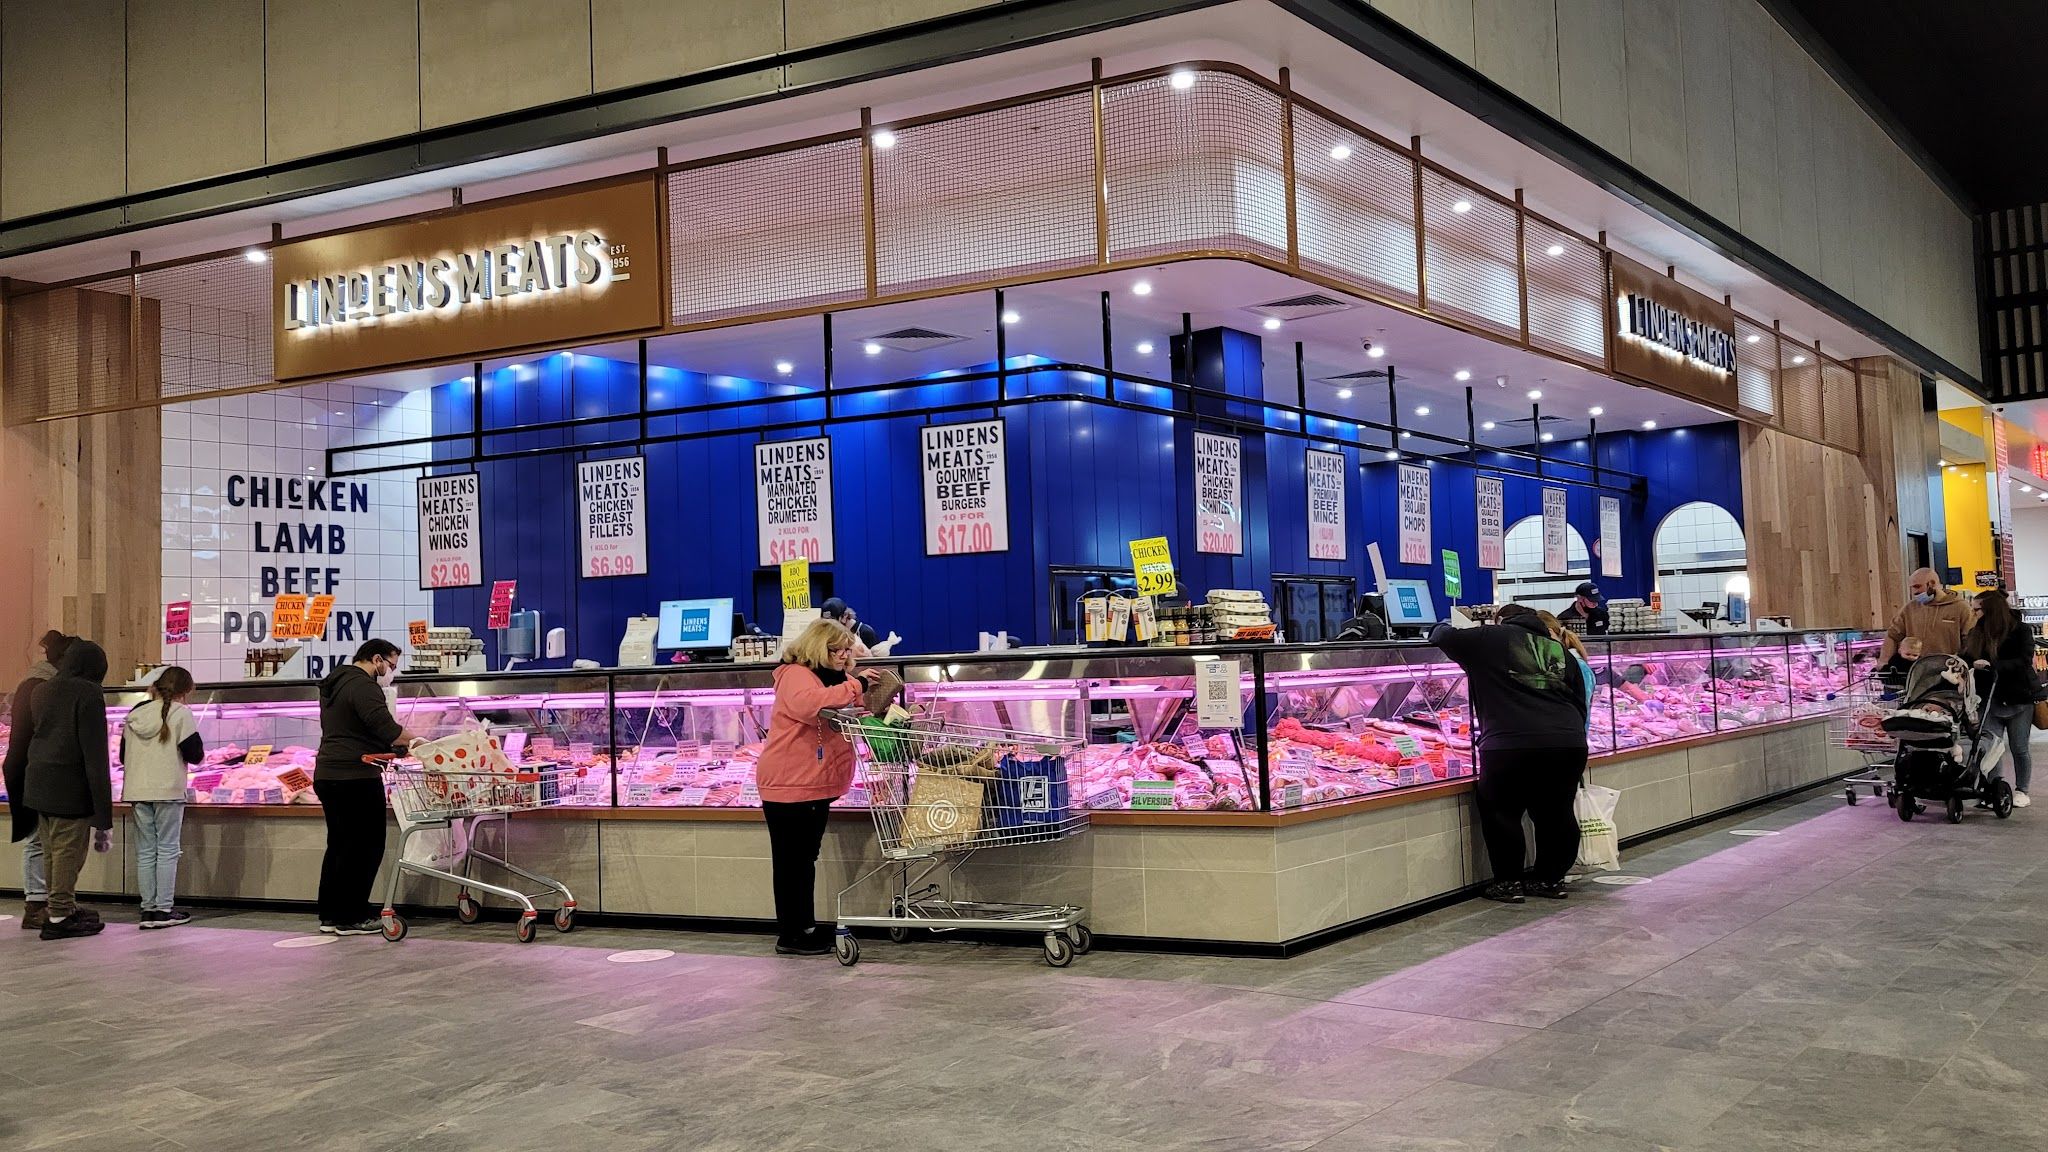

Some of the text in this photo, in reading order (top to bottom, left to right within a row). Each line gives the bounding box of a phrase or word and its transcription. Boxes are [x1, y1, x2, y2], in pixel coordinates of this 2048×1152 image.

[610, 244, 629, 256] EST.
[610, 256, 630, 268] 1956
[927, 426, 998, 450] LINDENS
[760, 442, 825, 466] LINDENS
[1197, 436, 1238, 458] LINDENS
[928, 448, 984, 470] MEATS
[1197, 456, 1229, 476] MEATS
[1308, 454, 1342, 474] LINDENS
[582, 462, 640, 483] LINDENS
[761, 464, 812, 486] MEATS
[936, 466, 990, 484] GOURMET
[1309, 472, 1336, 490] MEATS
[1400, 468, 1428, 486] LINDENS
[422, 478, 474, 498] LINDENS
[767, 480, 817, 498] MARINATED
[1202, 474, 1233, 490] CHICKEN
[1478, 480, 1502, 496] LINDENS
[228, 474, 368, 513] CHICKEN
[583, 482, 628, 502] MEATS
[936, 482, 990, 500] BEEF
[1202, 488, 1232, 500] BREAST
[1314, 488, 1338, 501] PREMIUM
[1400, 485, 1422, 501] MEATS
[422, 498, 464, 516] MEATS
[590, 499, 634, 513] CHICKEN
[768, 494, 817, 511] CHICKEN
[942, 497, 986, 511] BURGERS
[1314, 500, 1338, 512] BEEF
[1478, 496, 1496, 510] MEATS
[590, 512, 632, 524] BREAST
[768, 508, 818, 524] DRUMETTES
[960, 512, 984, 520] FOR
[1314, 510, 1338, 524] MINCE
[1481, 509, 1499, 517] QUALITY
[428, 514, 469, 532] CHICKEN
[590, 523, 634, 538] FILLETS
[1404, 516, 1426, 532] CHOPS
[1482, 518, 1499, 528] BBQ
[254, 522, 346, 554] LAMB
[428, 532, 468, 550] WINGS
[938, 522, 992, 555] $17.00
[1203, 532, 1234, 552] $20.00
[770, 538, 820, 564] $1500
[1132, 545, 1168, 560] CHICKEN
[430, 562, 470, 587] $2.99
[590, 555, 634, 577] $6.99
[790, 567, 800, 576] BBQ
[261, 566, 340, 598] BEEF
[782, 577, 808, 590] SAUSAGES
[276, 602, 305, 610] CHICKEN
[278, 614, 300, 622] KIEV'S
[682, 617, 708, 625] LINDENS
[682, 624, 701, 632] MEATS
